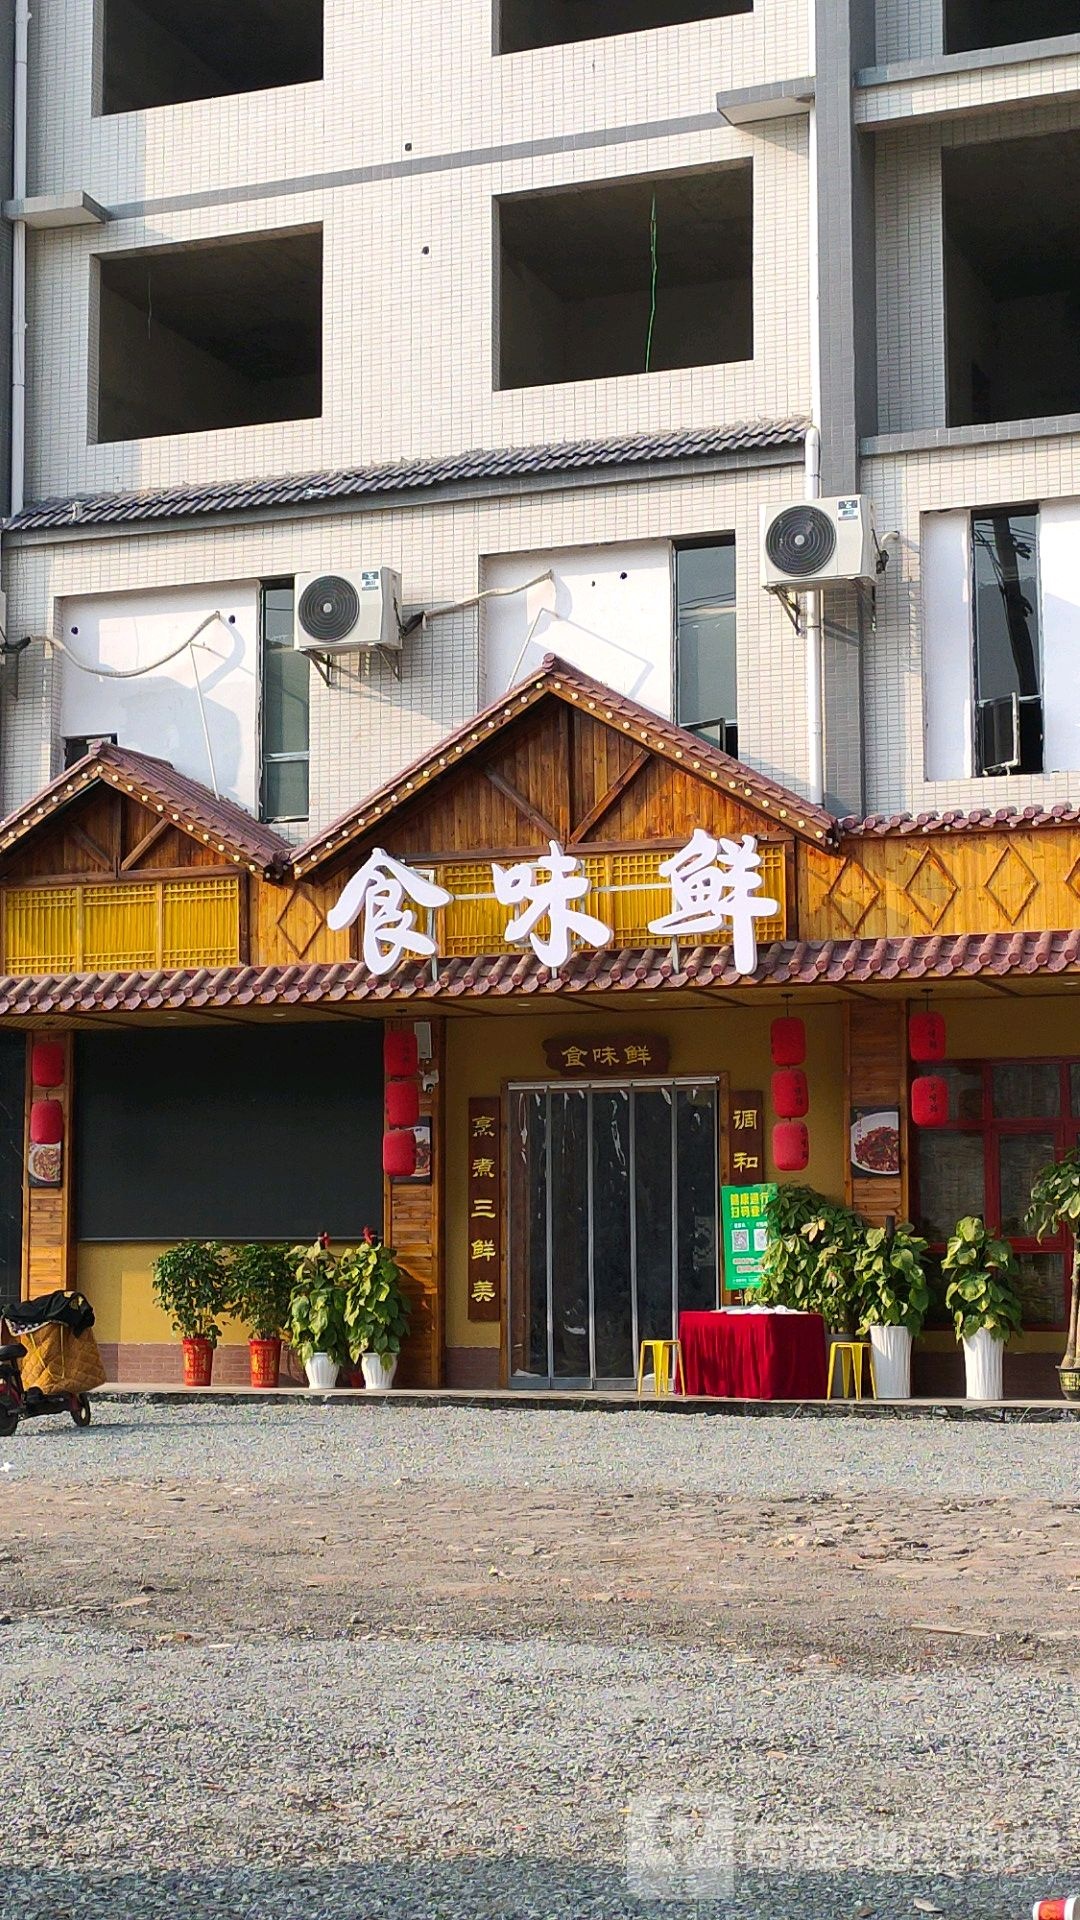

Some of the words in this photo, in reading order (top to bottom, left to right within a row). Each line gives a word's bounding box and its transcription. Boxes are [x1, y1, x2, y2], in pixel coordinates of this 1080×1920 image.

[328, 828, 779, 975] 食味鲜
[561, 1045, 652, 1067] 食味鲜
[471, 1115, 496, 1303] 烹煮三鲜美
